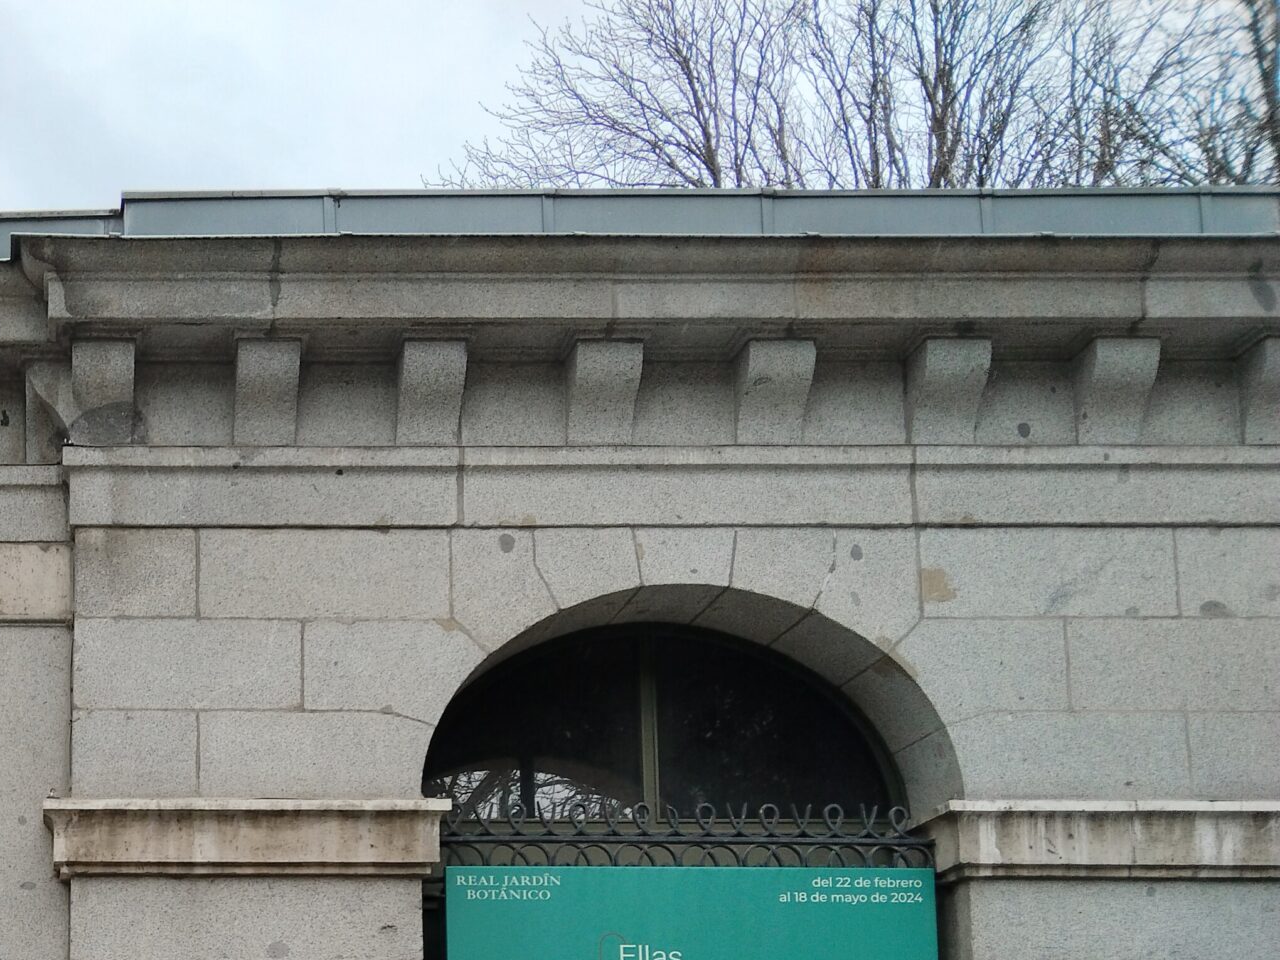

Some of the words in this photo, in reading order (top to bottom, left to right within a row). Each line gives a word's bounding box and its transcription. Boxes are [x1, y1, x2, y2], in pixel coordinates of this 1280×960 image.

[456, 875, 499, 886] REAL
[812, 877, 833, 888] del
[835, 877, 851, 888] 22
[854, 877, 871, 888] de
[874, 877, 923, 888] febrero
[779, 892, 791, 903] al
[793, 892, 808, 903] 18
[810, 892, 828, 903] de
[831, 893, 868, 905] mayo
[870, 892, 888, 903] de
[890, 892, 924, 903] 2024
